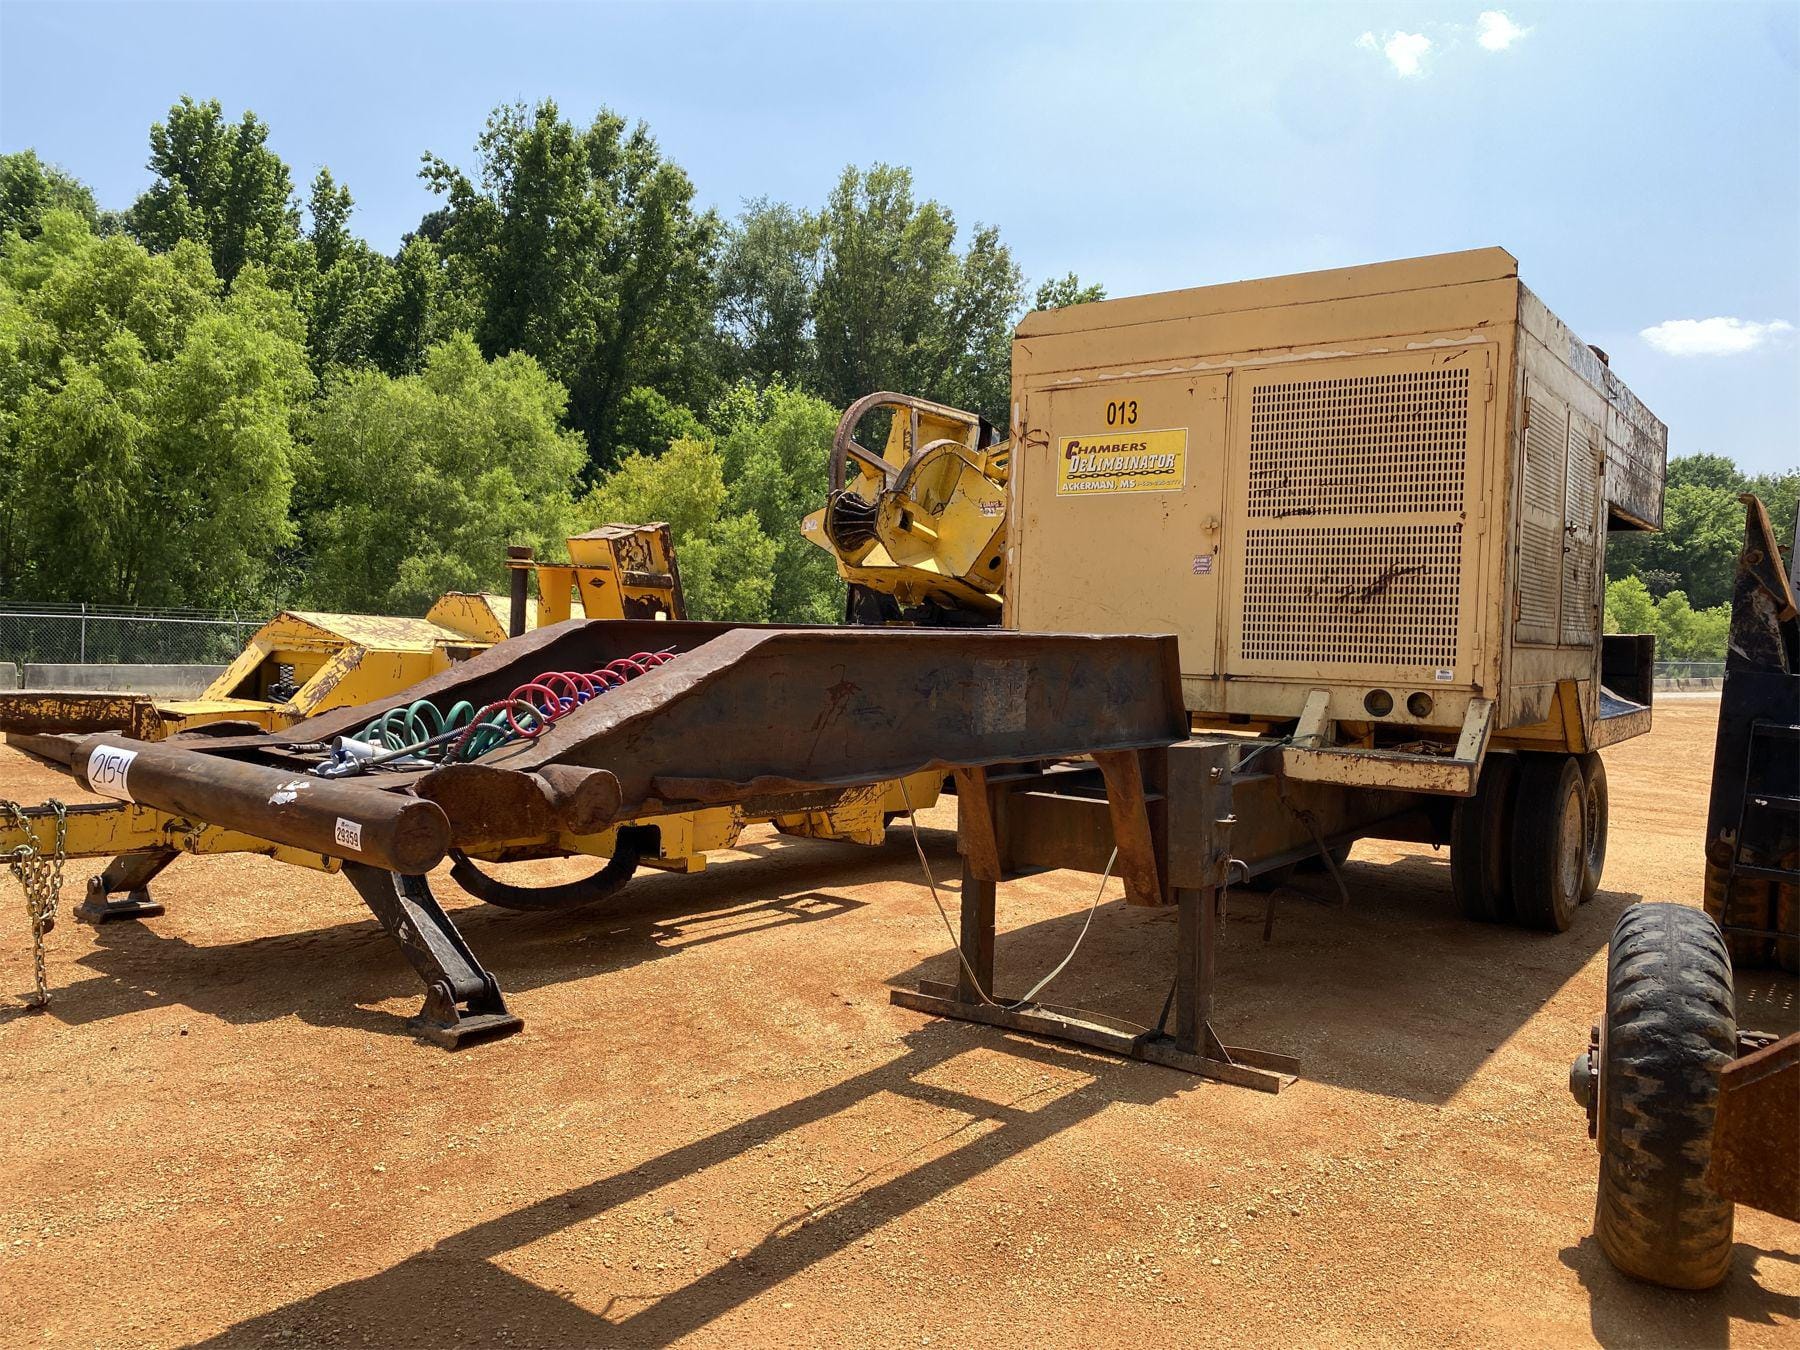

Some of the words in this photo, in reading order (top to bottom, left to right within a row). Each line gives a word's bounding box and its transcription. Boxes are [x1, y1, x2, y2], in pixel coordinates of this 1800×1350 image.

[1106, 401, 1138, 425] 013
[1066, 441, 1147, 459] CHAMBERS
[1062, 481, 1118, 491] ACKERMAN,
[1120, 480, 1136, 488] MS
[92, 753, 130, 789] 2154
[337, 826, 358, 847] 29359
